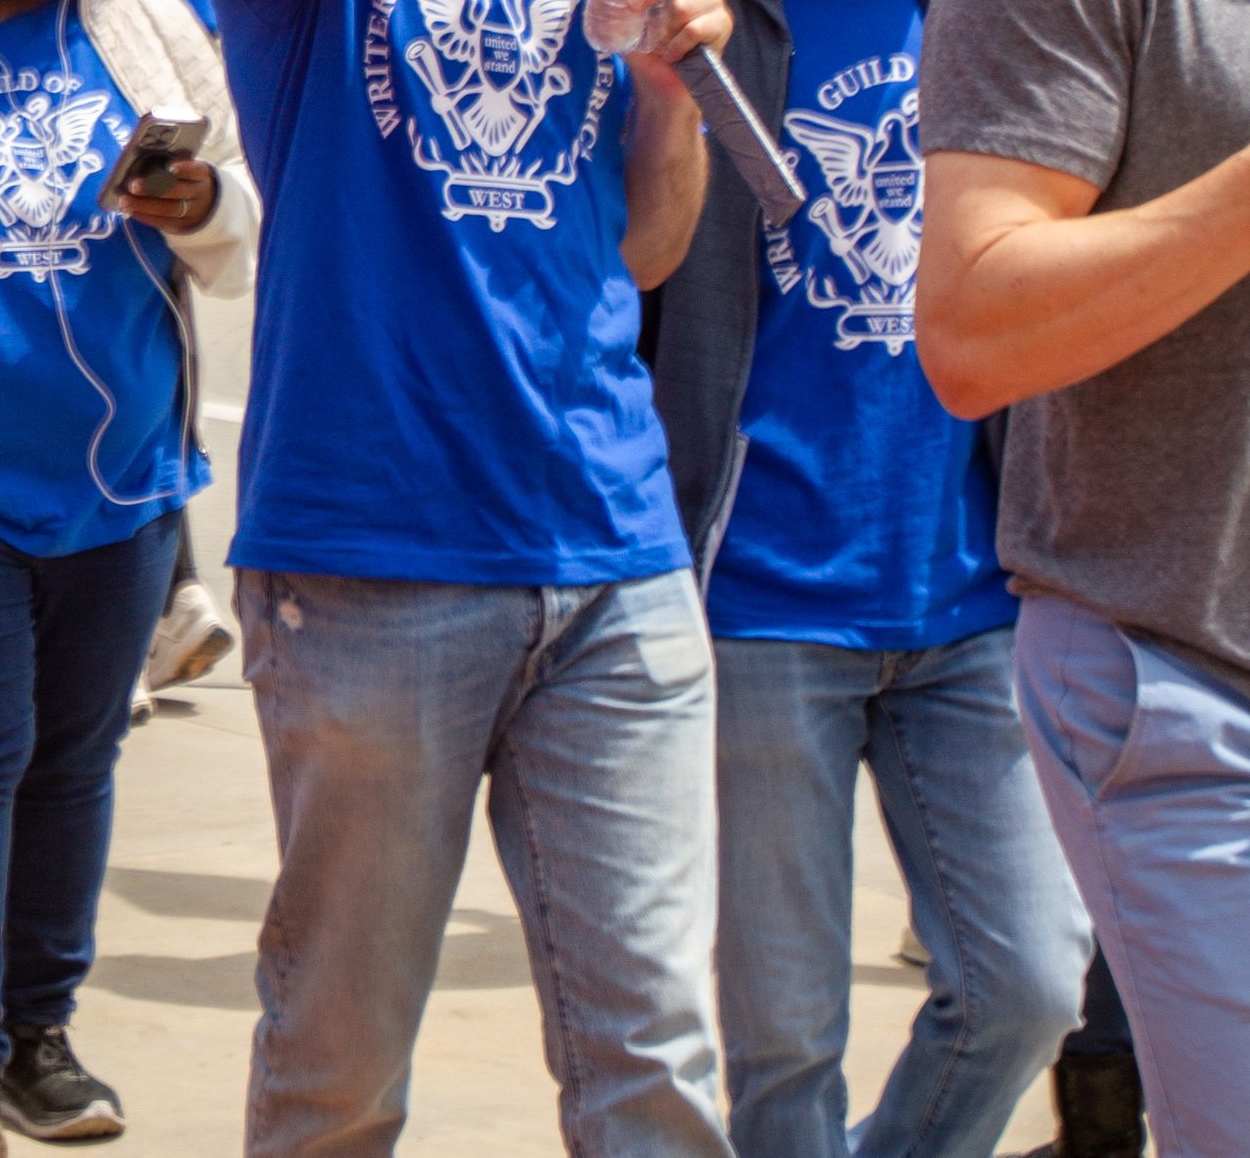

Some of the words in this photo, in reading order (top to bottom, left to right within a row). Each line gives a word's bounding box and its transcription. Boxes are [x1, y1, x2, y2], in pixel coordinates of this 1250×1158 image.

[484, 35, 518, 51] united
[493, 50, 511, 60] we
[484, 59, 517, 75] stand
[43, 75, 82, 95] OF
[817, 55, 914, 111] GUILD
[468, 189, 527, 210] WEST
[15, 250, 63, 267] WEST
